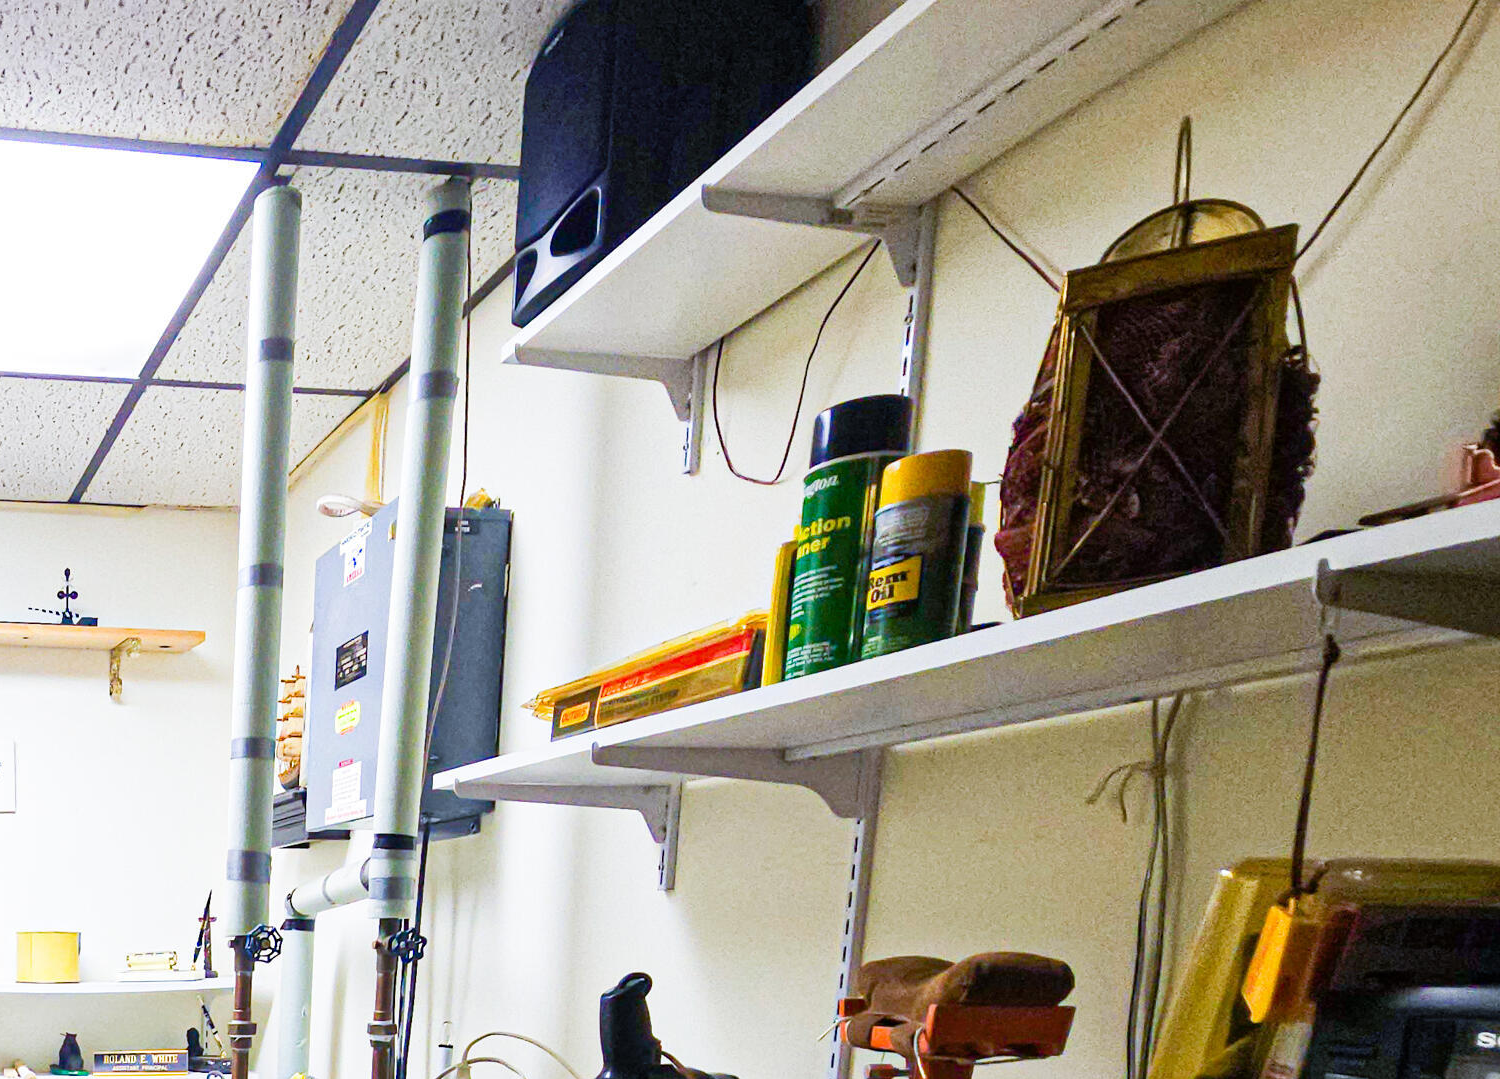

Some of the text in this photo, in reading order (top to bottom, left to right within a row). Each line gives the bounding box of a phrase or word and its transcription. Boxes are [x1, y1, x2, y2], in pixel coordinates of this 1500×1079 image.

[871, 584, 895, 603] Oil
[103, 1054, 137, 1064] ROLAND
[151, 1054, 179, 1064] WHITE
